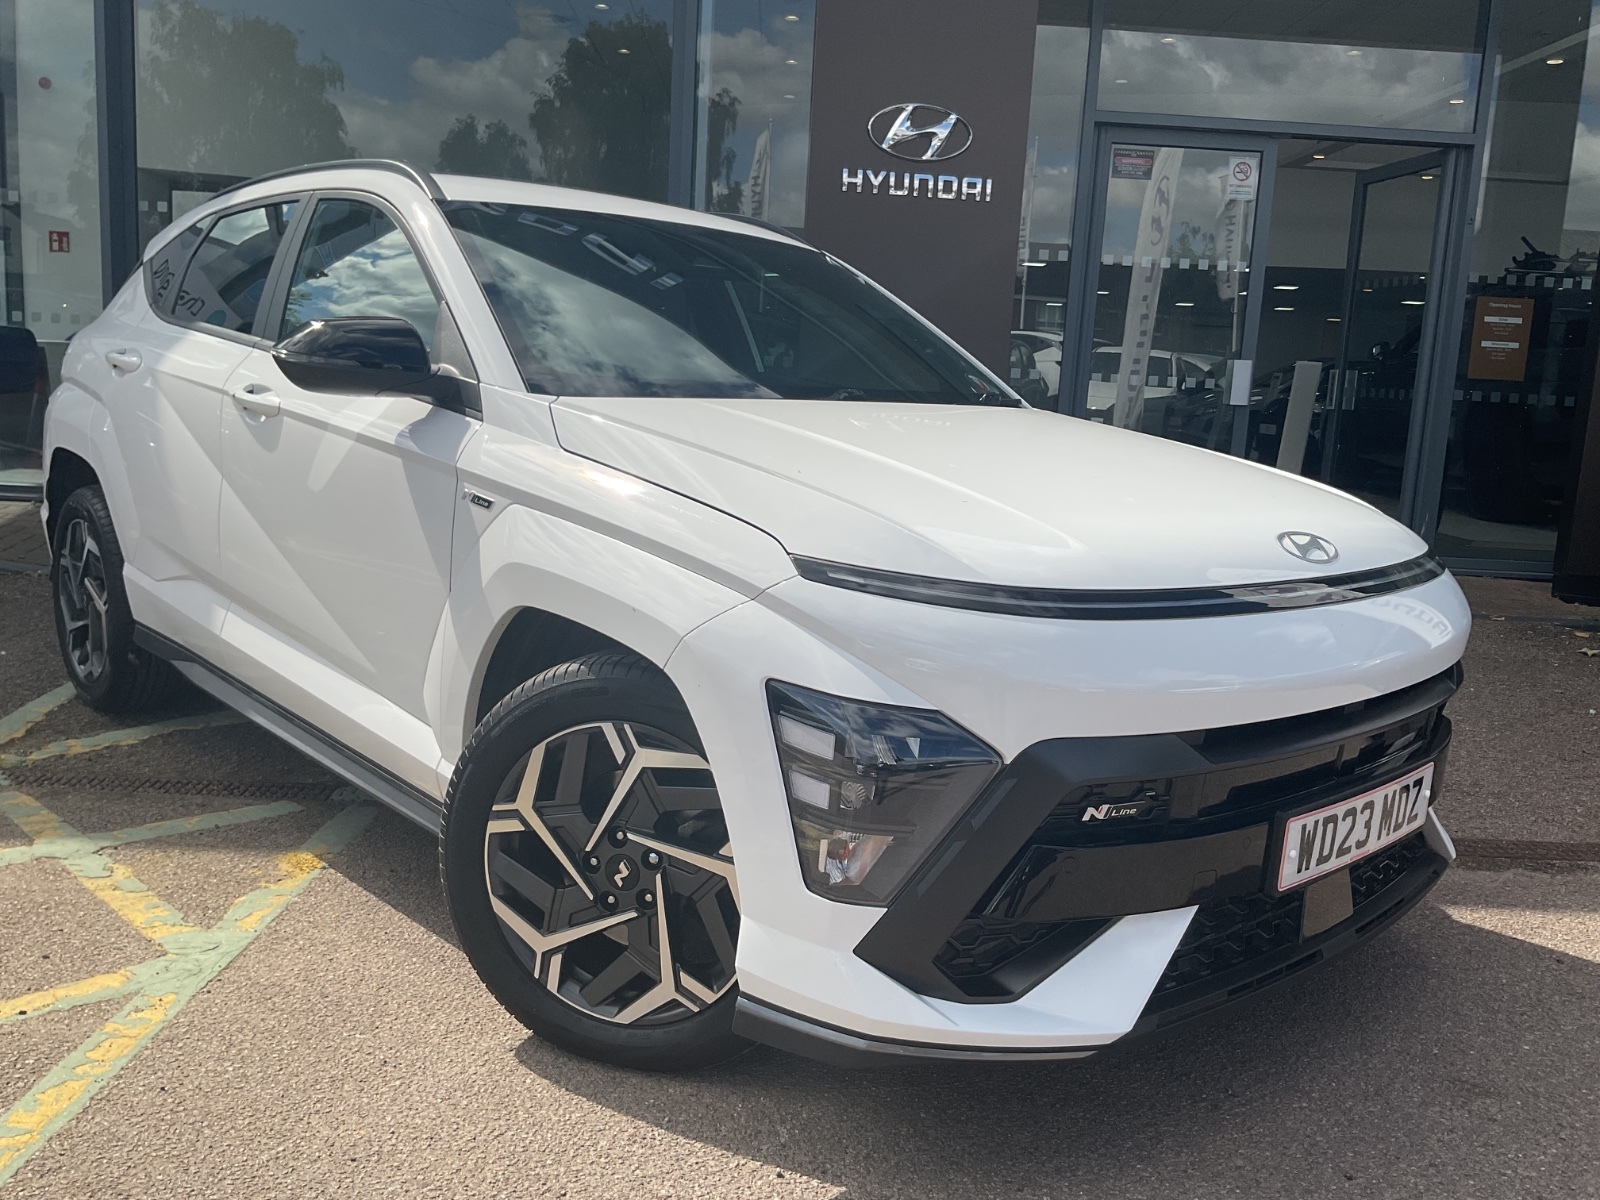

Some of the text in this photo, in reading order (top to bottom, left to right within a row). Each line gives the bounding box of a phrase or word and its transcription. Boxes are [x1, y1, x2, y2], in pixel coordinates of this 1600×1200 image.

[842, 168, 992, 202] HYUNDAI
[1111, 808, 1137, 817] Line
[1297, 775, 1425, 875] WD23 MDZ
